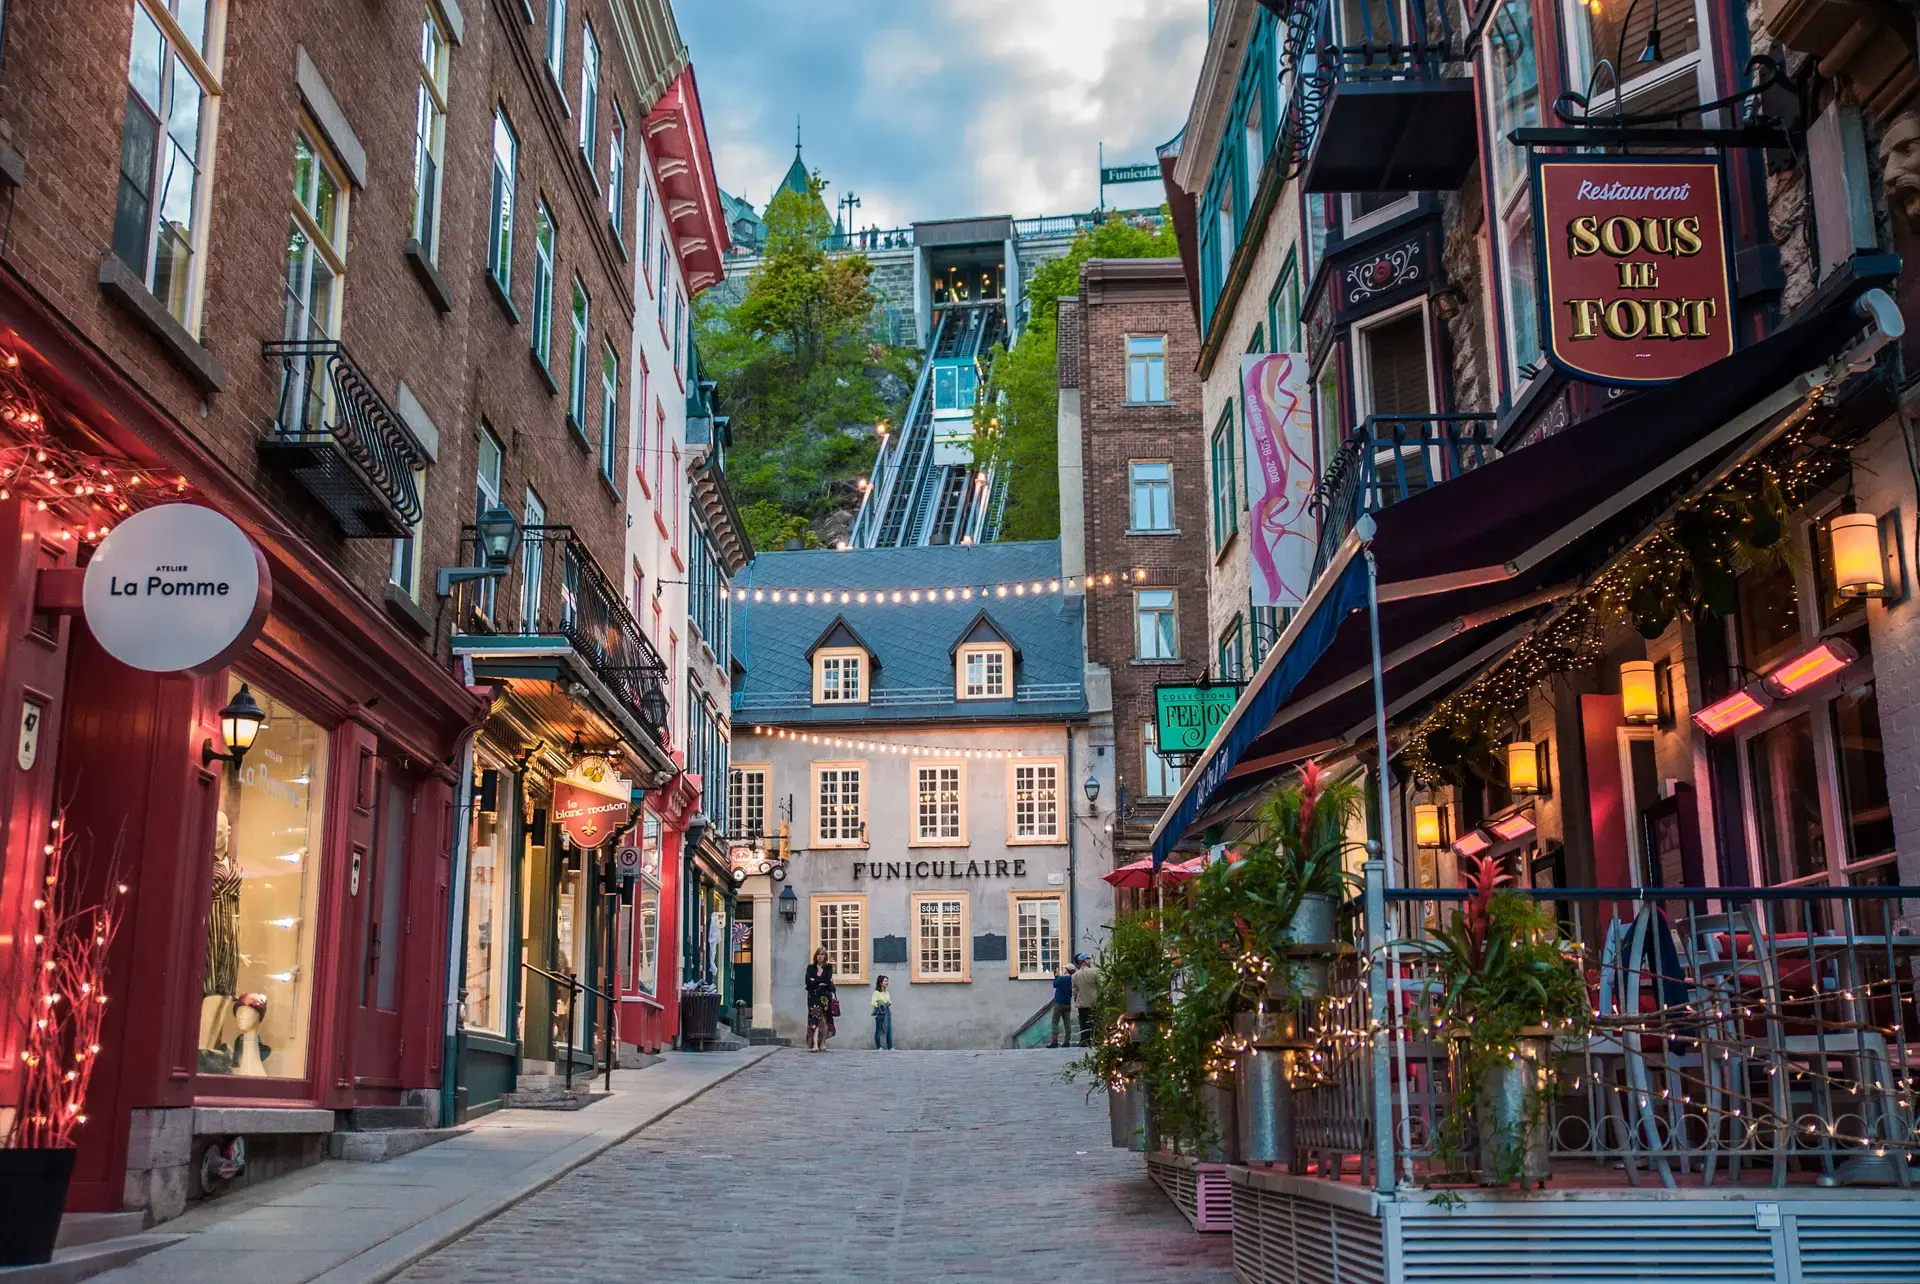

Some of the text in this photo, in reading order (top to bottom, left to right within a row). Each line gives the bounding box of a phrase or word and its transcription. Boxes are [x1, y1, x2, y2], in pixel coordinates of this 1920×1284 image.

[1109, 167, 1161, 180] Funiculai
[1577, 180, 1691, 200] Restaurant
[1569, 216, 1703, 259] SOUS
[1617, 262, 1659, 290] LE
[1565, 298, 1717, 340] FORT
[155, 565, 189, 573] ATELIER
[110, 576, 230, 596] La Pomme
[1162, 692, 1231, 701] COLLECTIONS
[238, 763, 255, 787] La
[555, 802, 627, 819] blanc mouton
[567, 800, 578, 809] le
[852, 859, 1027, 880] FUNICULAIRE
[921, 903, 961, 913] SOUVENIRS
